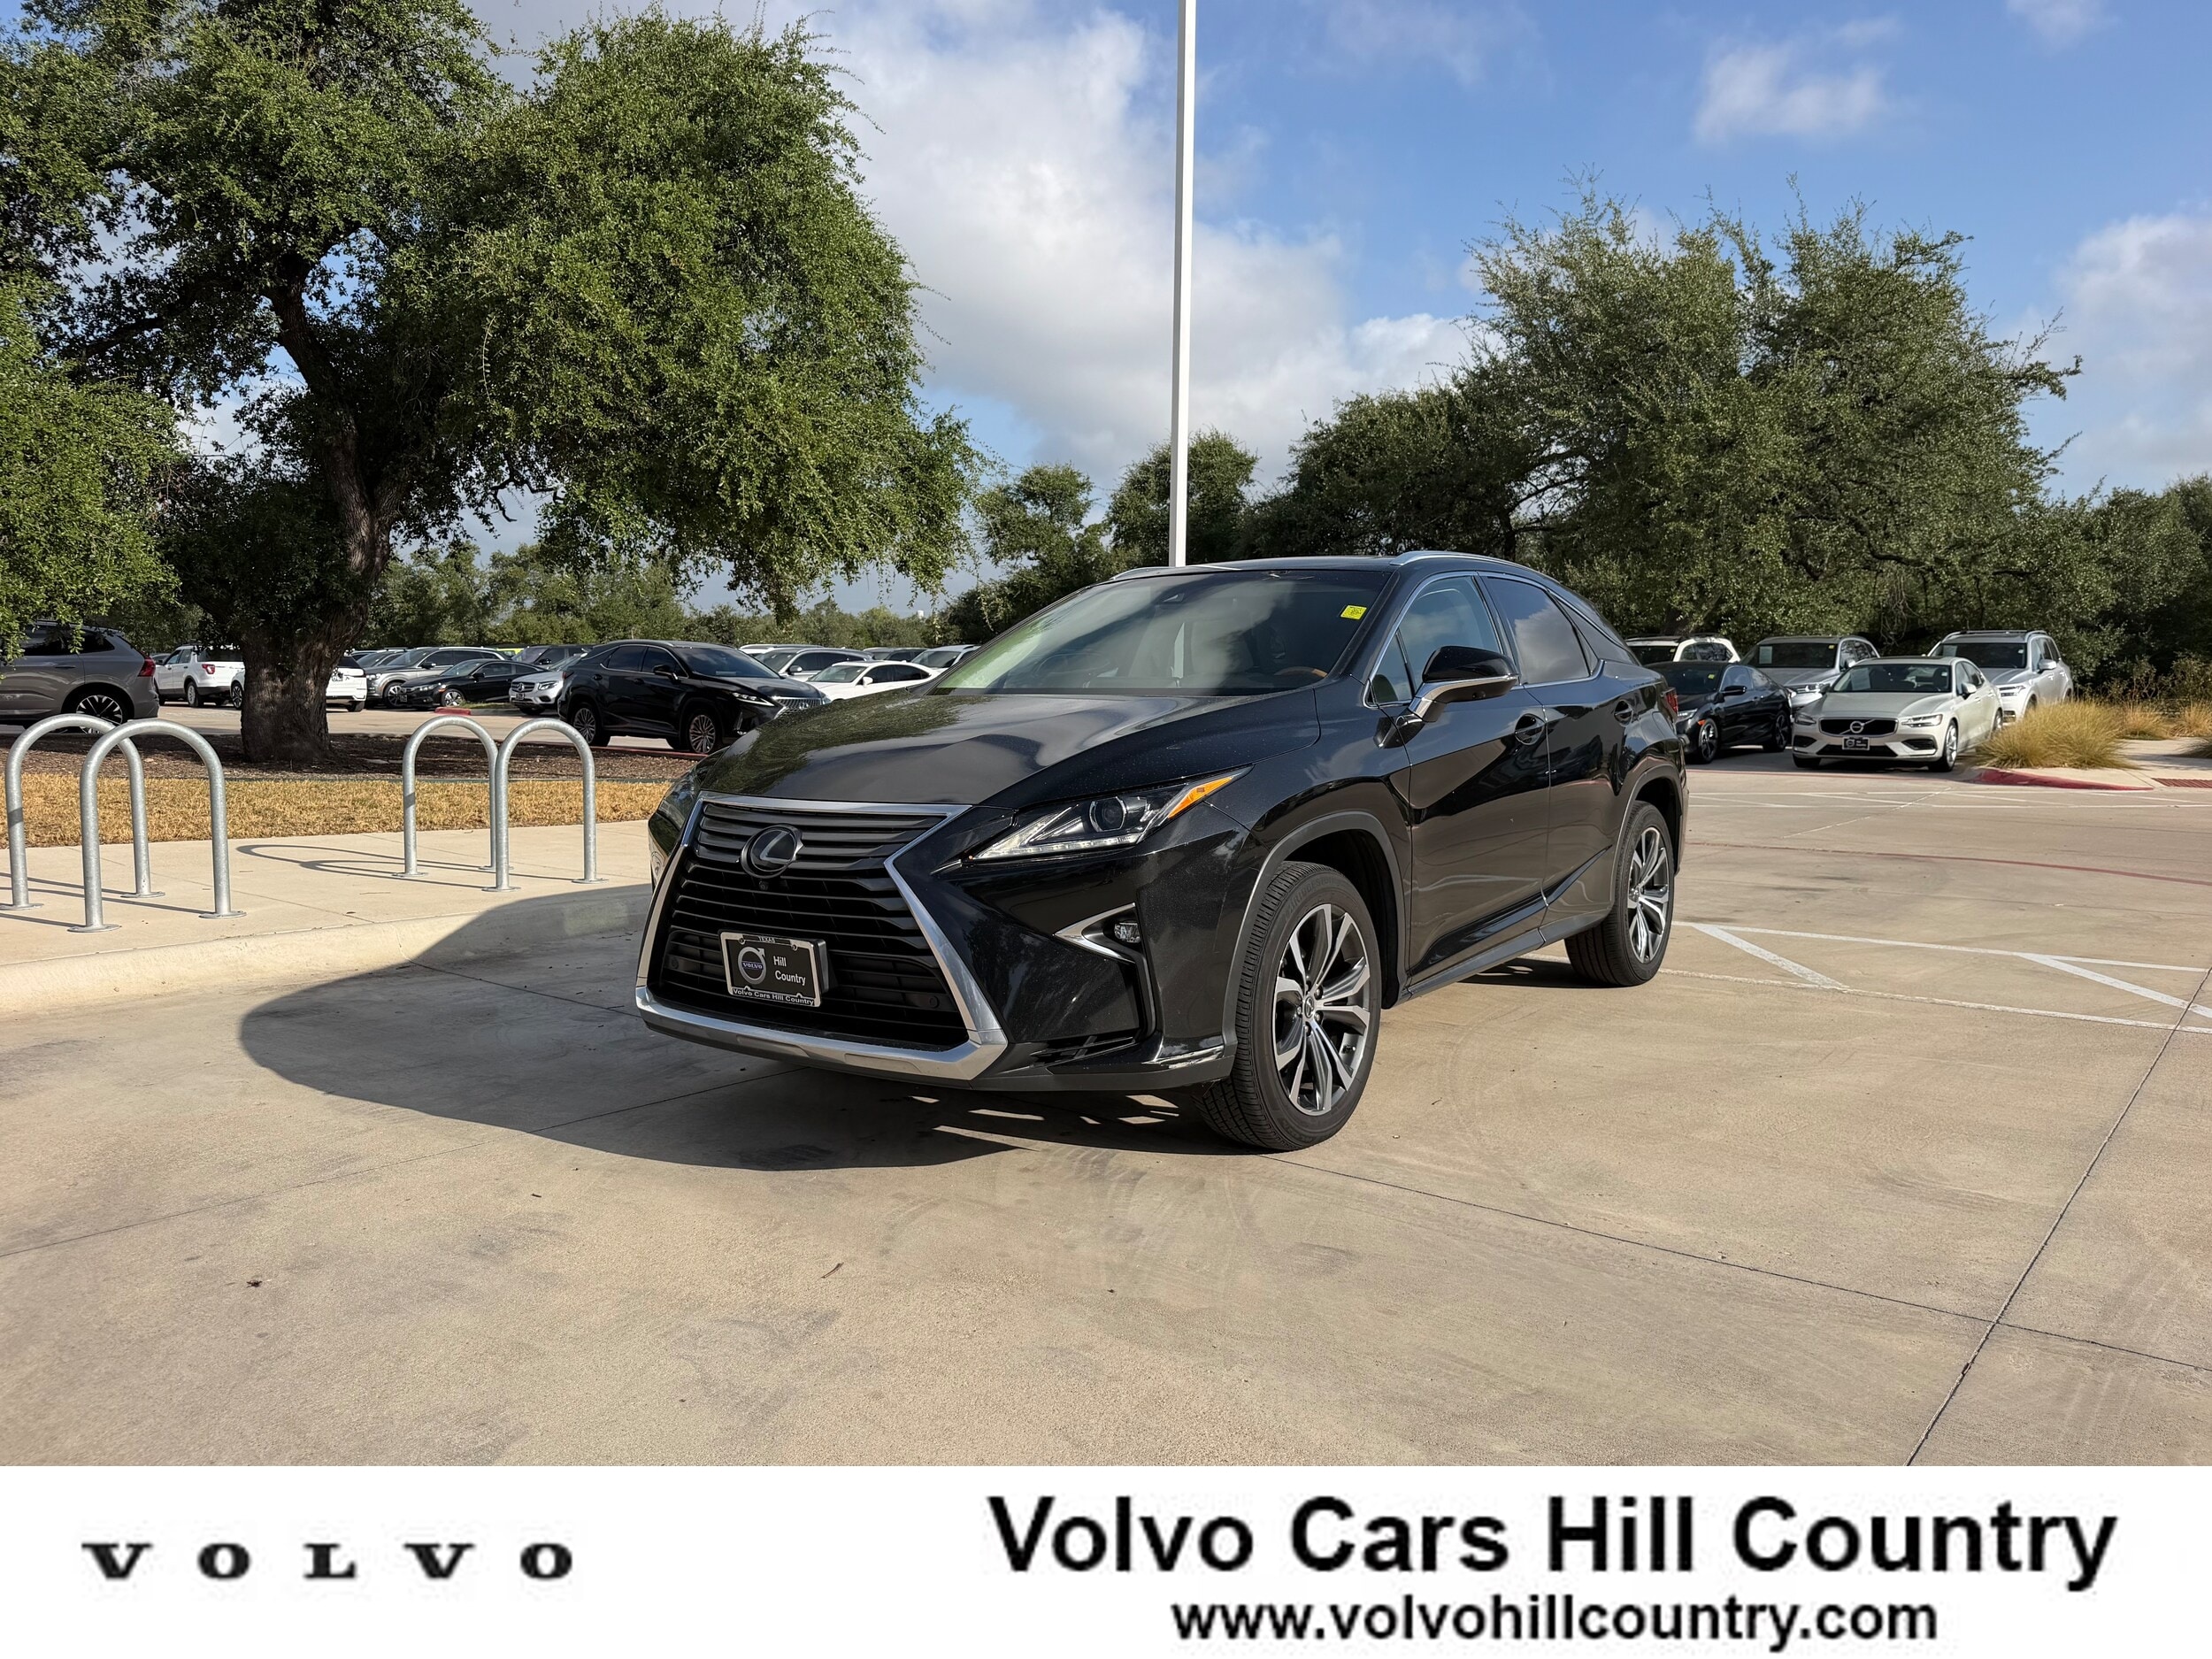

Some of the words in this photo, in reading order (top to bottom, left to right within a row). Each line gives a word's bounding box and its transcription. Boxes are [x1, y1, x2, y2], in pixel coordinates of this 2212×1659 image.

[773, 956, 787, 967] Hill
[774, 970, 806, 986] Country
[786, 995, 814, 1006] Country
